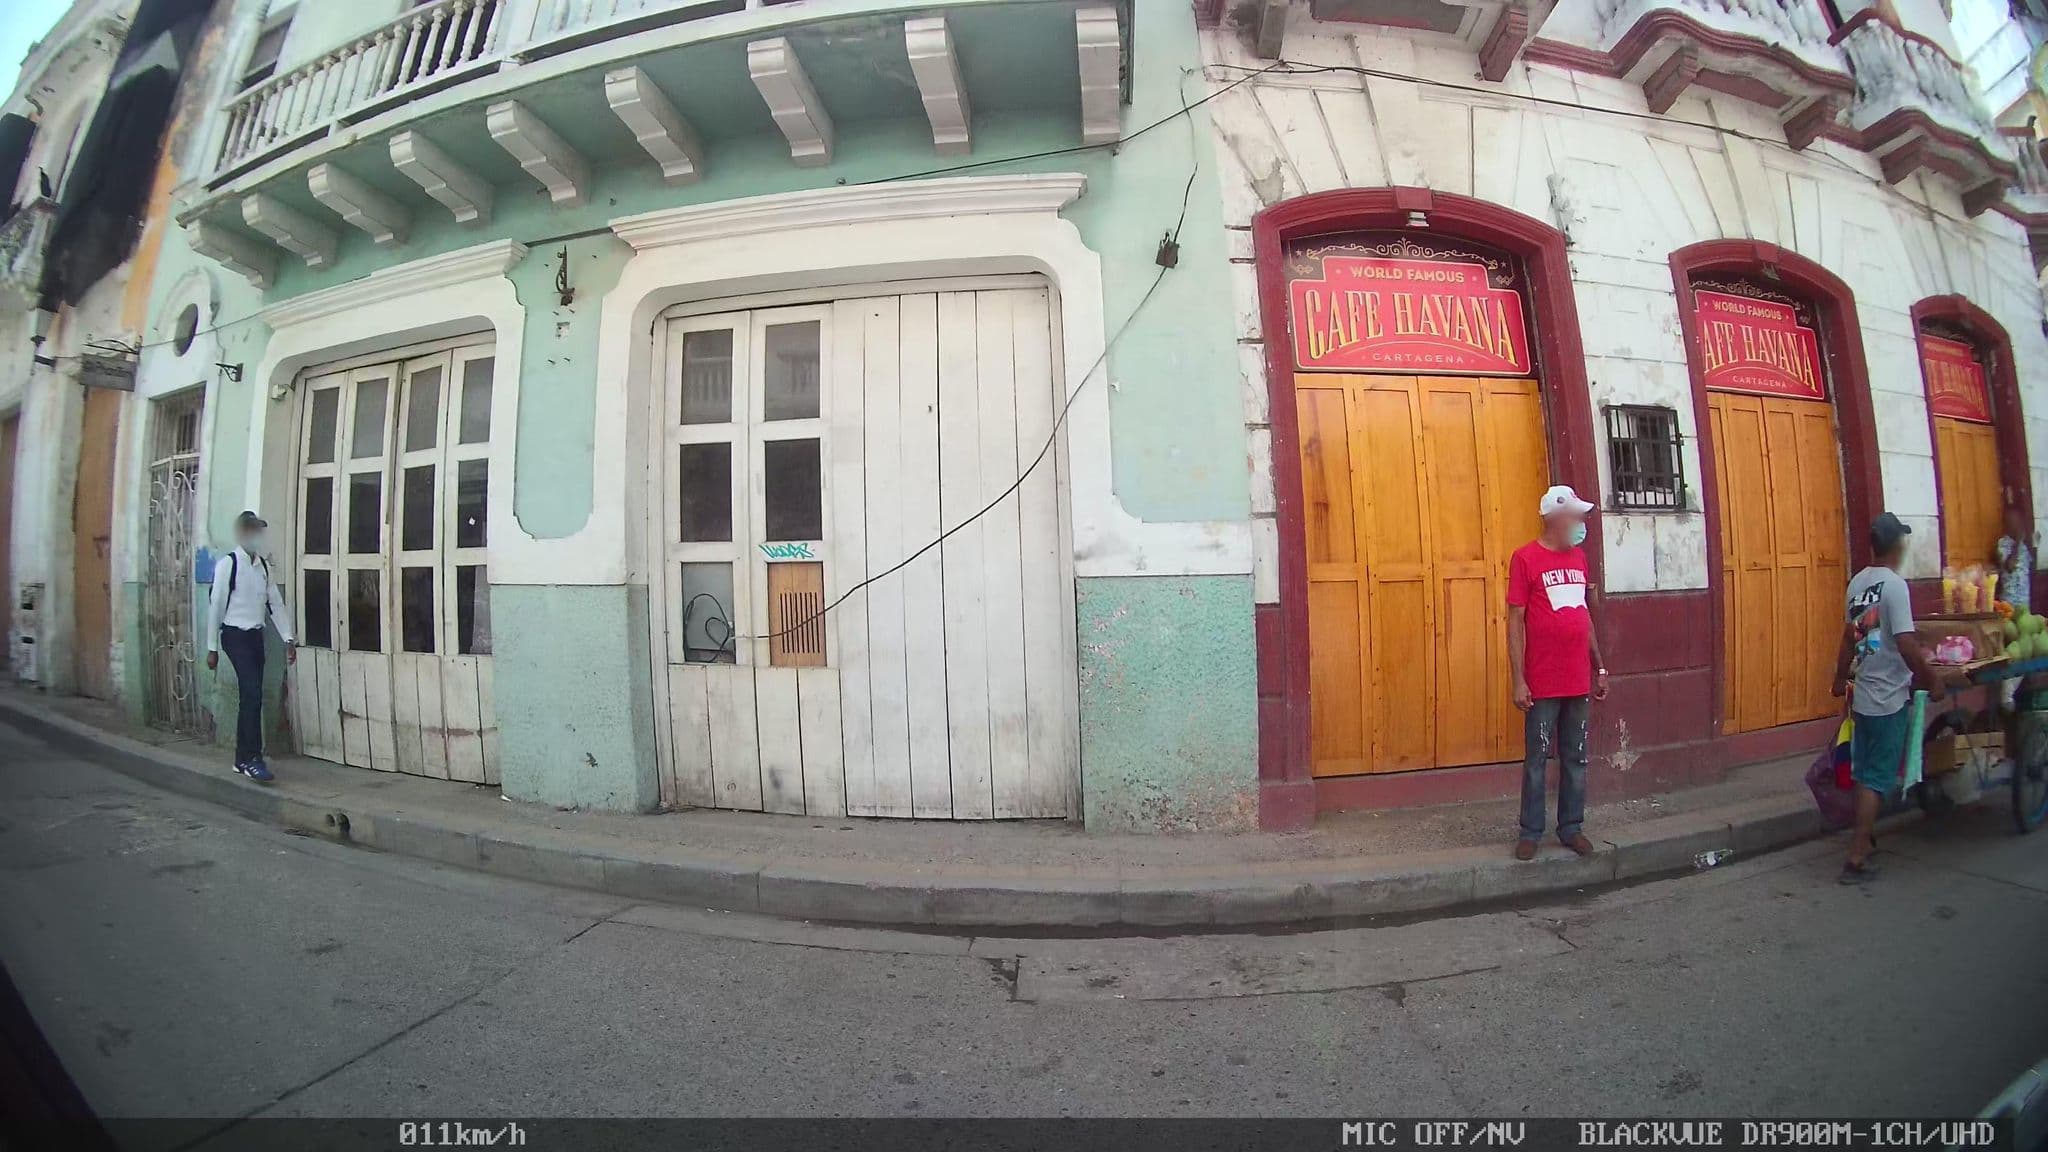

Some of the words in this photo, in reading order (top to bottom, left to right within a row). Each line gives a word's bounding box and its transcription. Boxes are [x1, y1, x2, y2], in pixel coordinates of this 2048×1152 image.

[1350, 265, 1403, 280] WORLD
[1406, 268, 1465, 284] FAMOUS
[1713, 301, 1745, 314] WORLD
[1747, 306, 1782, 320] FAMOUS
[1305, 289, 1383, 360] CAFE
[1392, 291, 1519, 368] HAVANA
[1372, 352, 1465, 365] CARTAGENA
[1703, 320, 1738, 374] AFE
[1740, 324, 1818, 393] HAVANA
[1732, 375, 1787, 388] CARTAGENA
[1542, 569, 1564, 587] NEW
